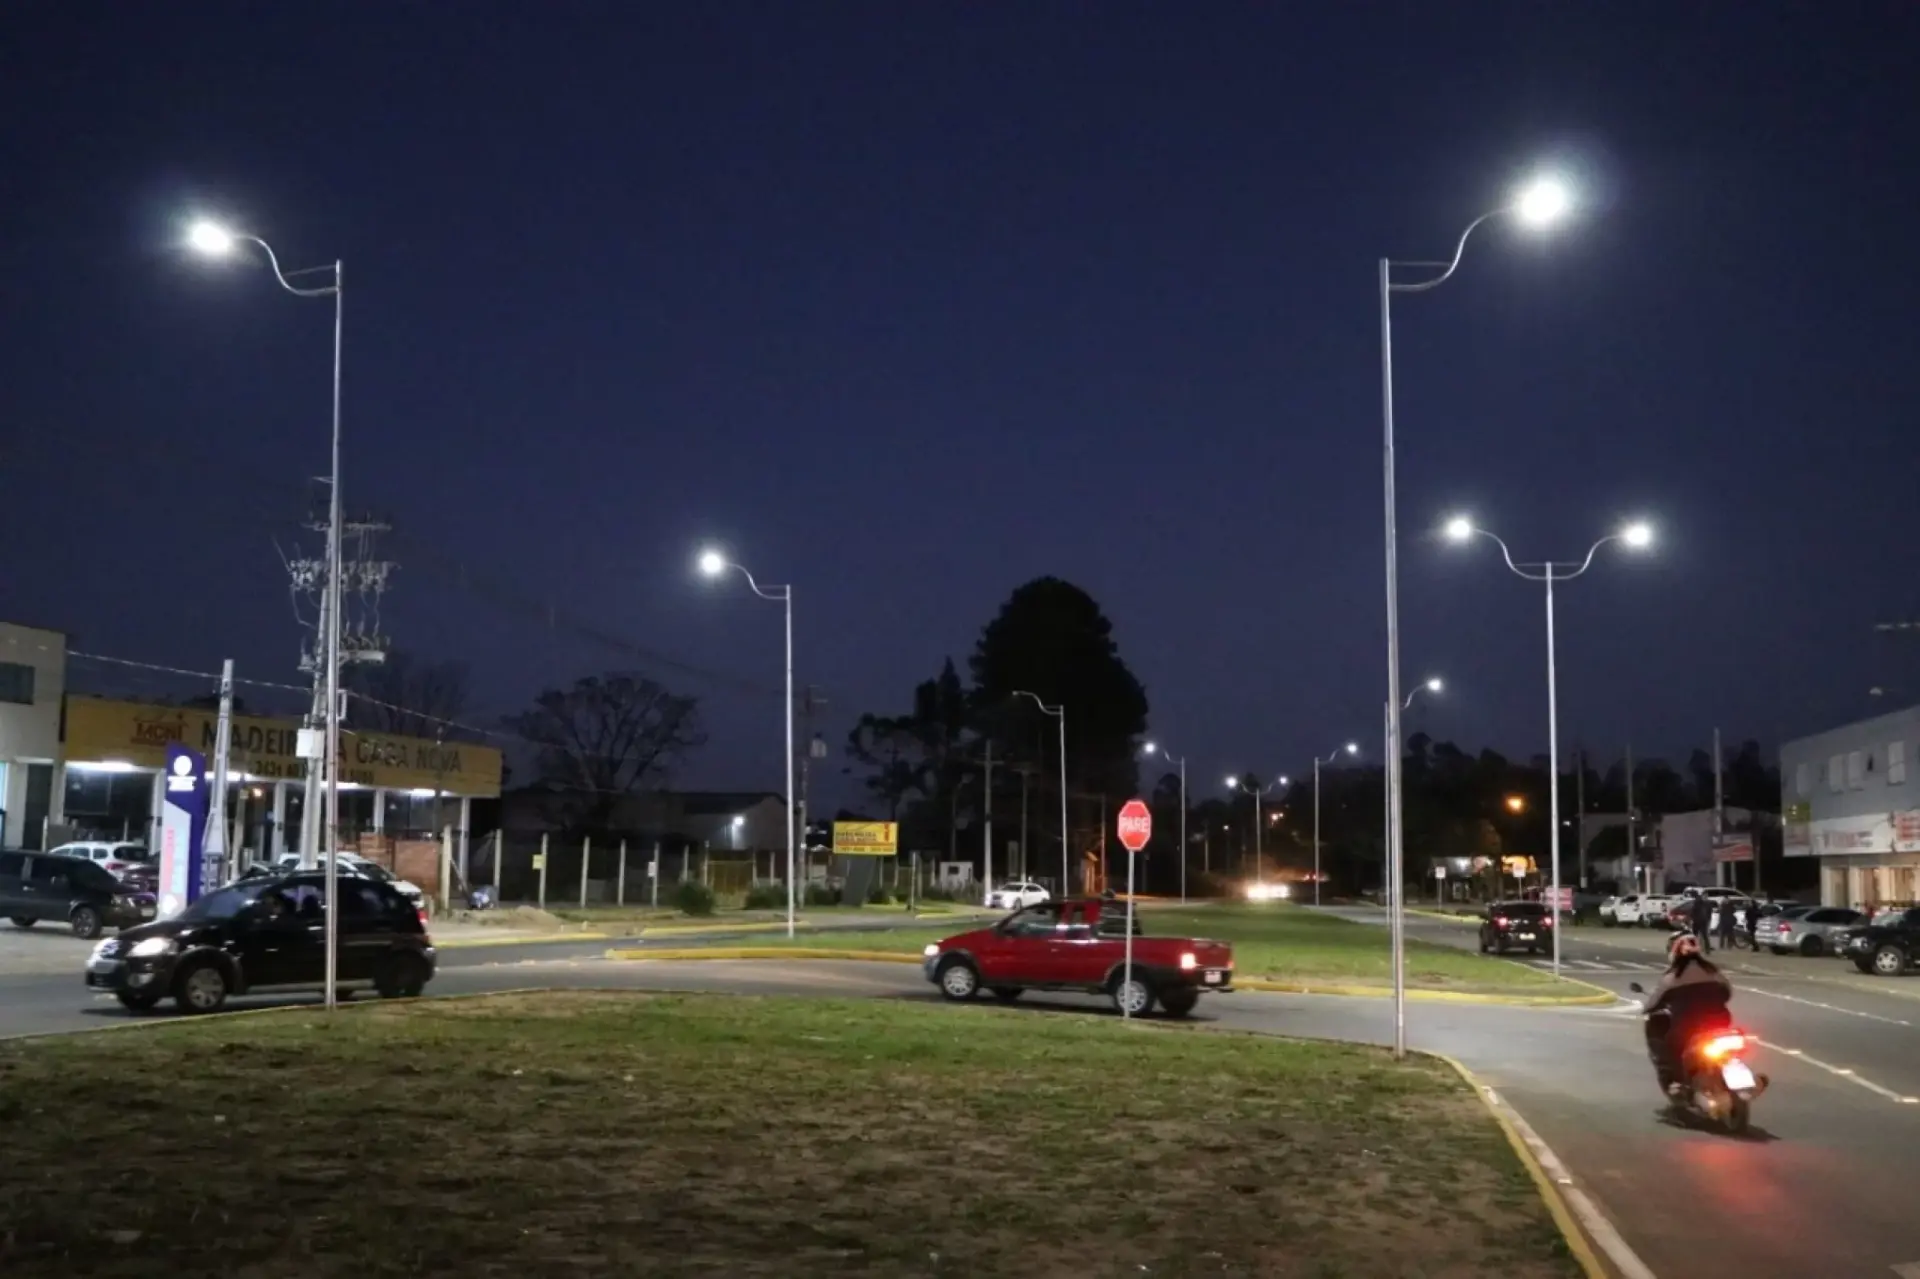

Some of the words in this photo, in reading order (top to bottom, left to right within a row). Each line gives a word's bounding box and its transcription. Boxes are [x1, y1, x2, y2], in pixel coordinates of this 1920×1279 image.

[356, 737, 410, 769] CASA
[416, 745, 462, 773] NOVA
[1120, 816, 1149, 832] PARE
